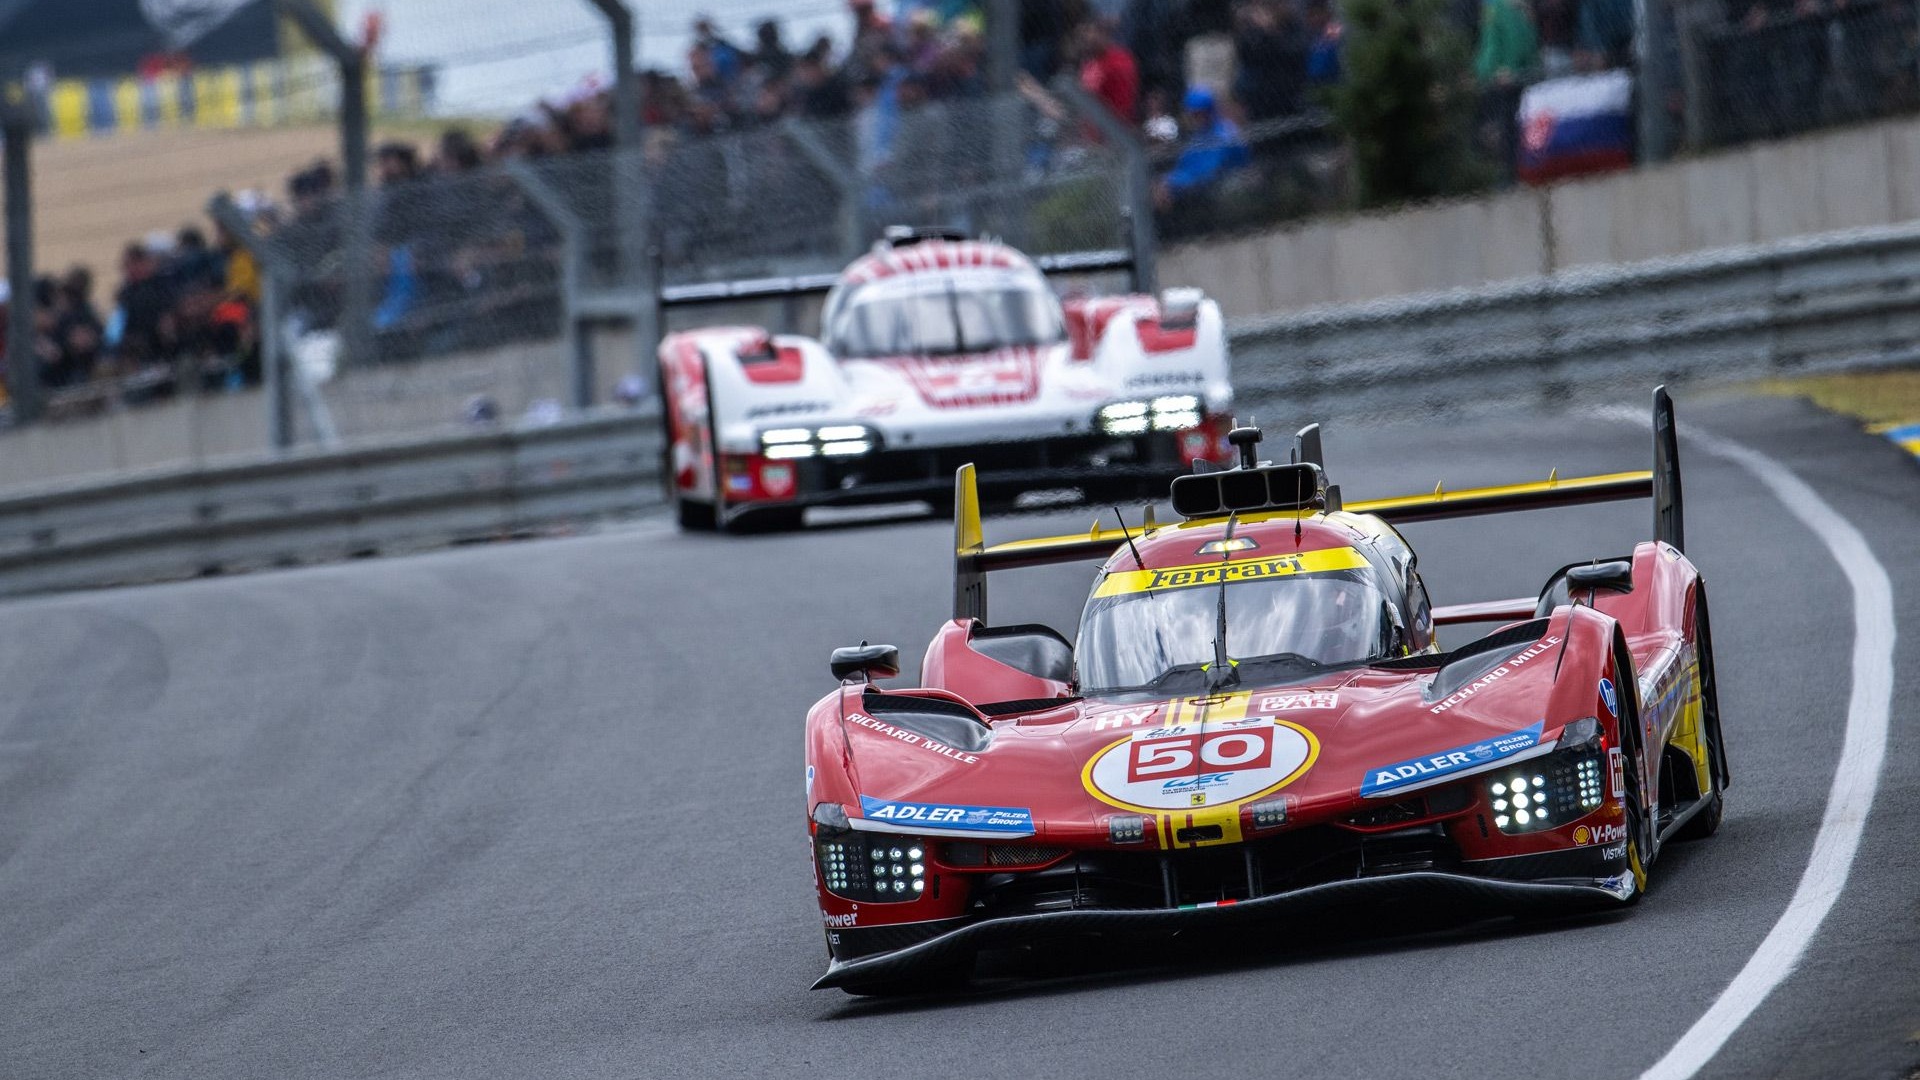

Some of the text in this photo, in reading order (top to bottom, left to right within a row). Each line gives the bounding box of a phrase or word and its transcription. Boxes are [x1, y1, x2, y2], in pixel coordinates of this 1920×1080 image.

[1145, 553, 1306, 589] Ferrari
[1430, 635, 1563, 714] RICHARD MILLE
[846, 712, 980, 764] RICHARD MILLE
[1492, 733, 1530, 747] PELZER
[1498, 739, 1534, 753] GROUP
[1136, 733, 1265, 776] 50
[1375, 751, 1471, 786] ADLER
[1162, 772, 1235, 788] WEC
[869, 805, 966, 822] ADLER
[987, 817, 1024, 826] GROUP
[992, 811, 1029, 819] PELZER
